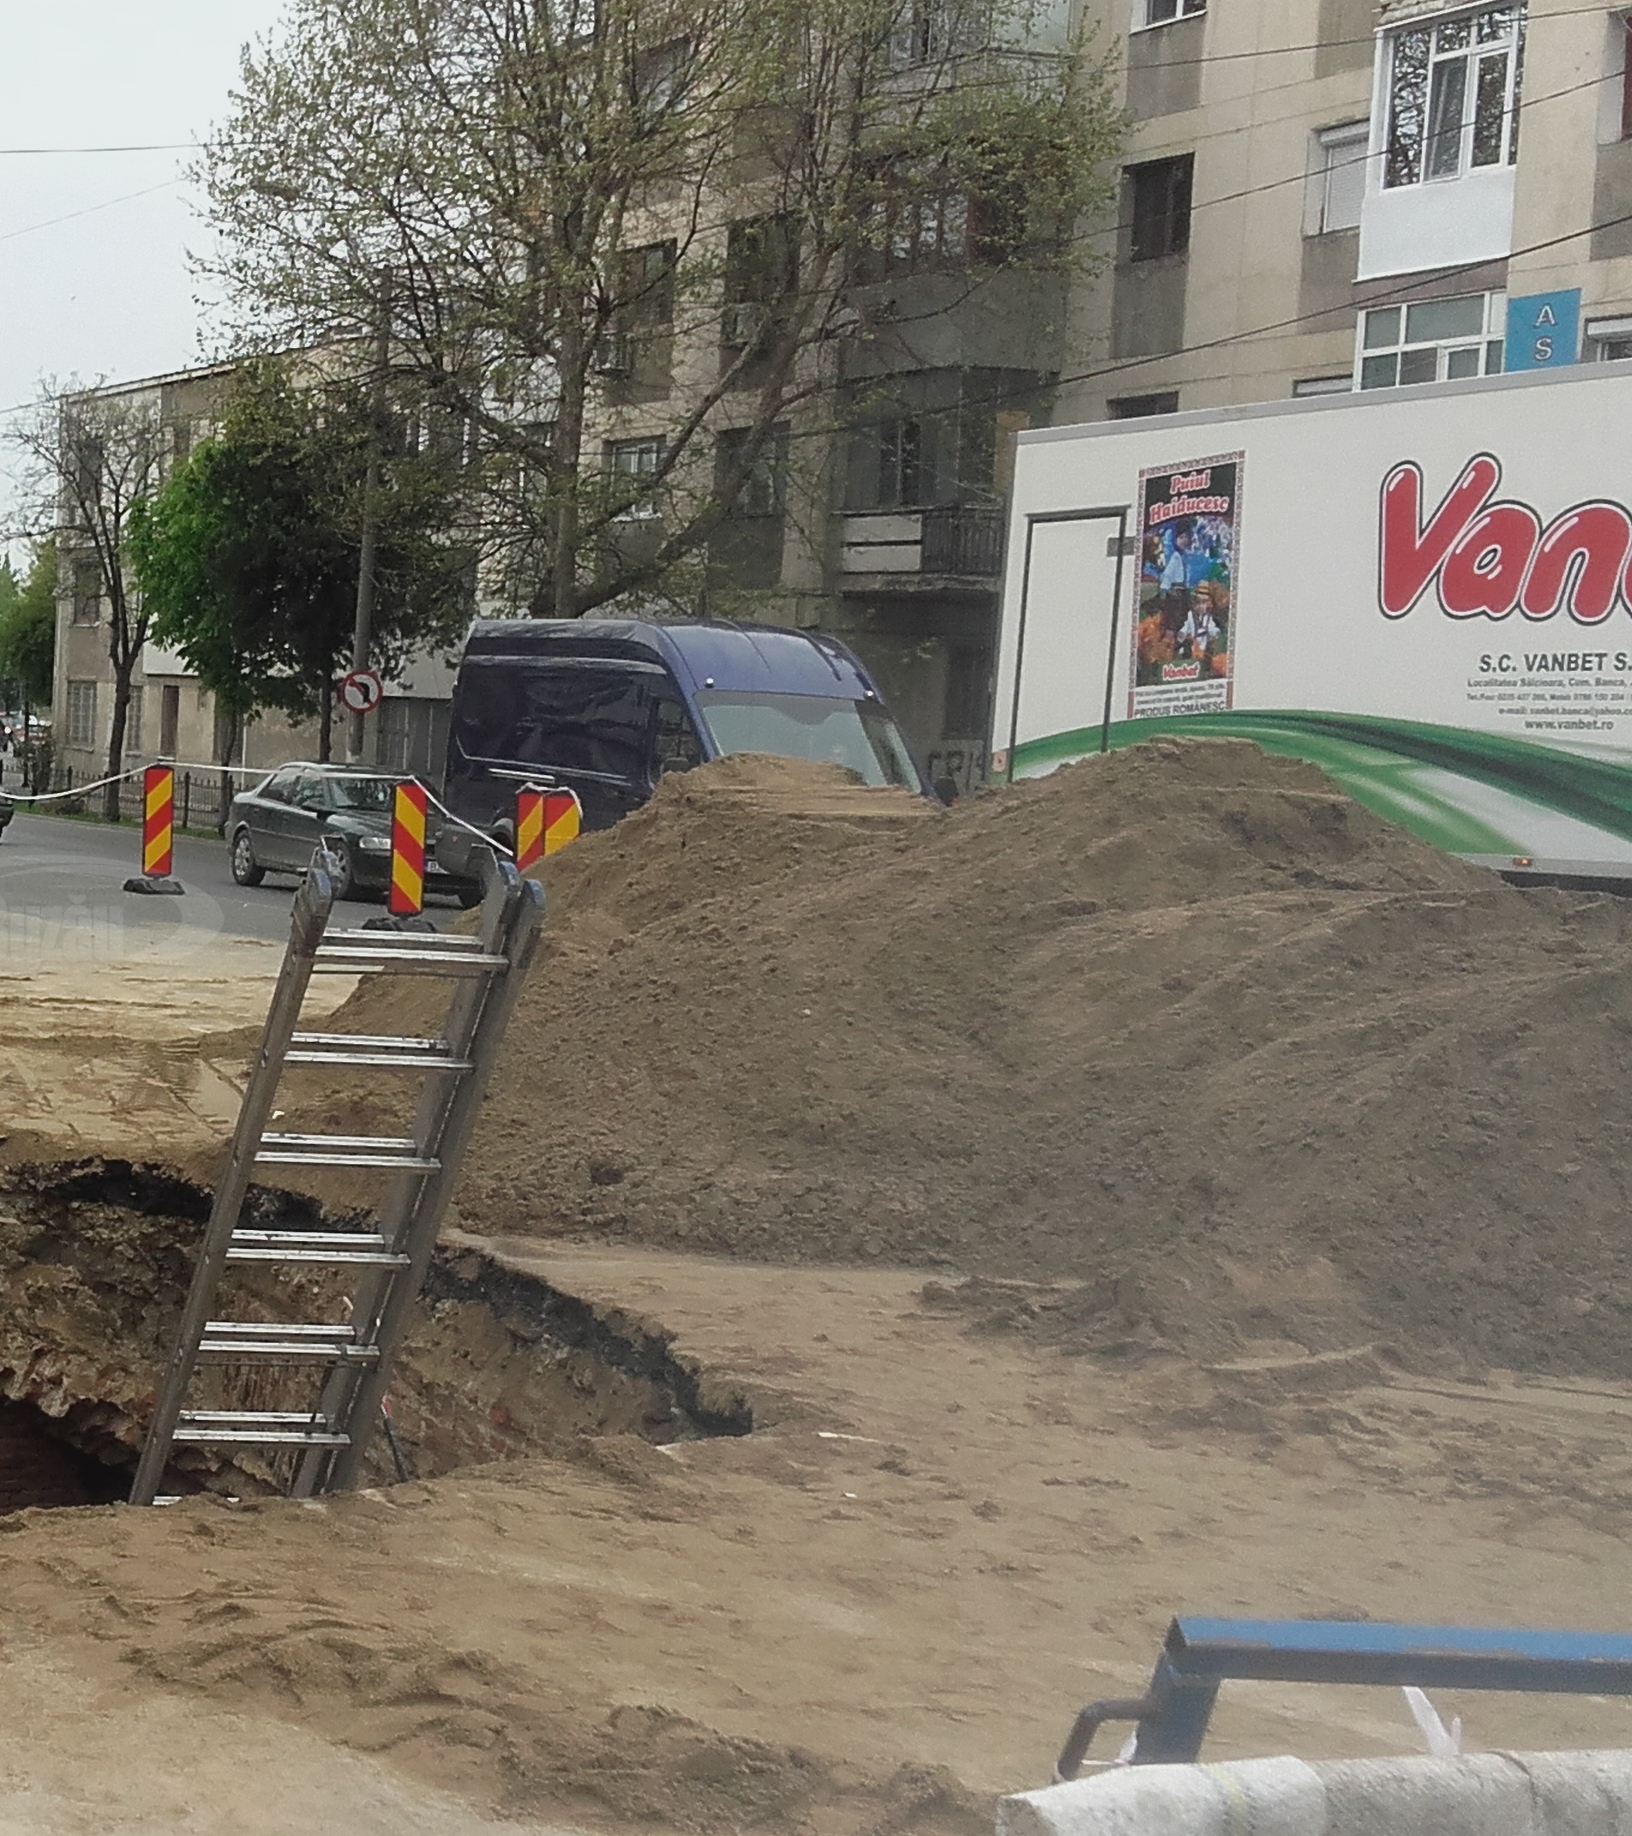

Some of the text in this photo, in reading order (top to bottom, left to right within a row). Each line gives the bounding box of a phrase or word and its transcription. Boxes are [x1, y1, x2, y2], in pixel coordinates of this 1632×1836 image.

[1170, 469, 1211, 494] Puiul
[1149, 495, 1230, 525] Haiducesc
[1378, 451, 1632, 626] Van
[1479, 654, 1517, 672] S.C.
[1523, 653, 1608, 672] VANBET
[1134, 705, 1171, 718] PRODUS
[1524, 718, 1614, 730] www.vanbet.ro
